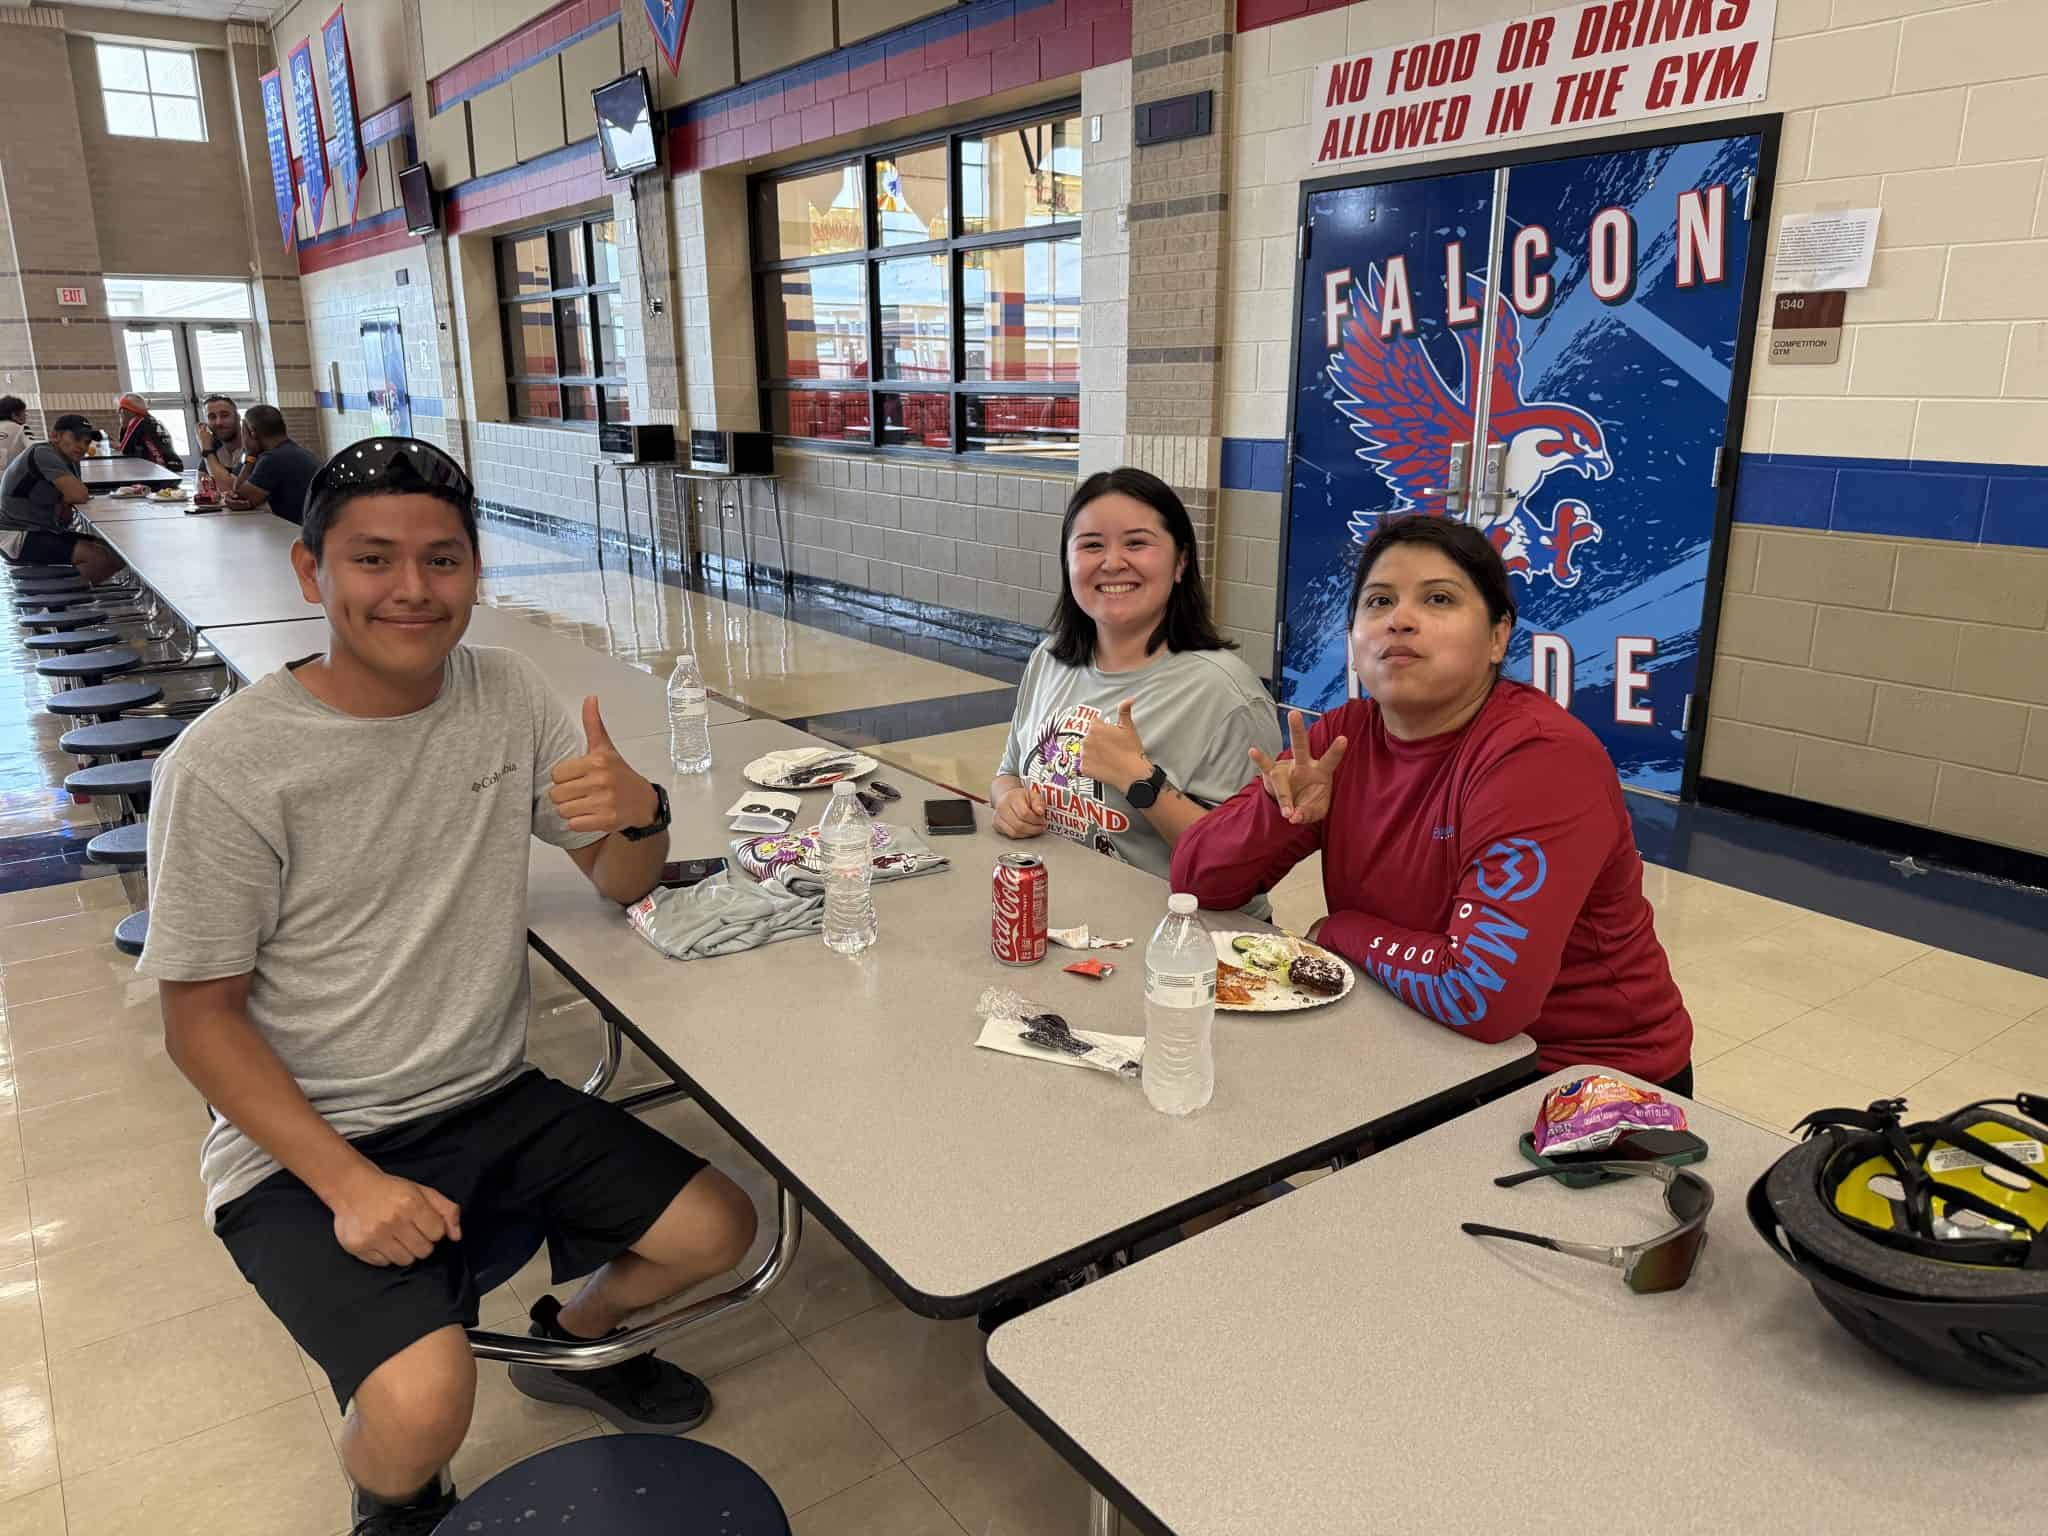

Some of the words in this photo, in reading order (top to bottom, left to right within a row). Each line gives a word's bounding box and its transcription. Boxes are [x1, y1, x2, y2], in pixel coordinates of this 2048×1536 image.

[1325, 56, 1373, 107] NO
[1386, 32, 1481, 96] FOOD
[1497, 16, 1556, 74] OR
[1572, 0, 1751, 60] DRINKS
[1318, 94, 1471, 162] ALLOWED
[1485, 82, 1534, 136] IN
[1550, 64, 1629, 126] THE
[1644, 41, 1760, 111] GYM
[1324, 184, 1726, 348] FALCON
[62, 289, 81, 302] EXIT
[1779, 298, 1805, 310] 1340
[1772, 348, 1790, 356] GYM
[1774, 340, 1827, 348] COMPETITION
[1045, 811, 1088, 833] ENTURY
